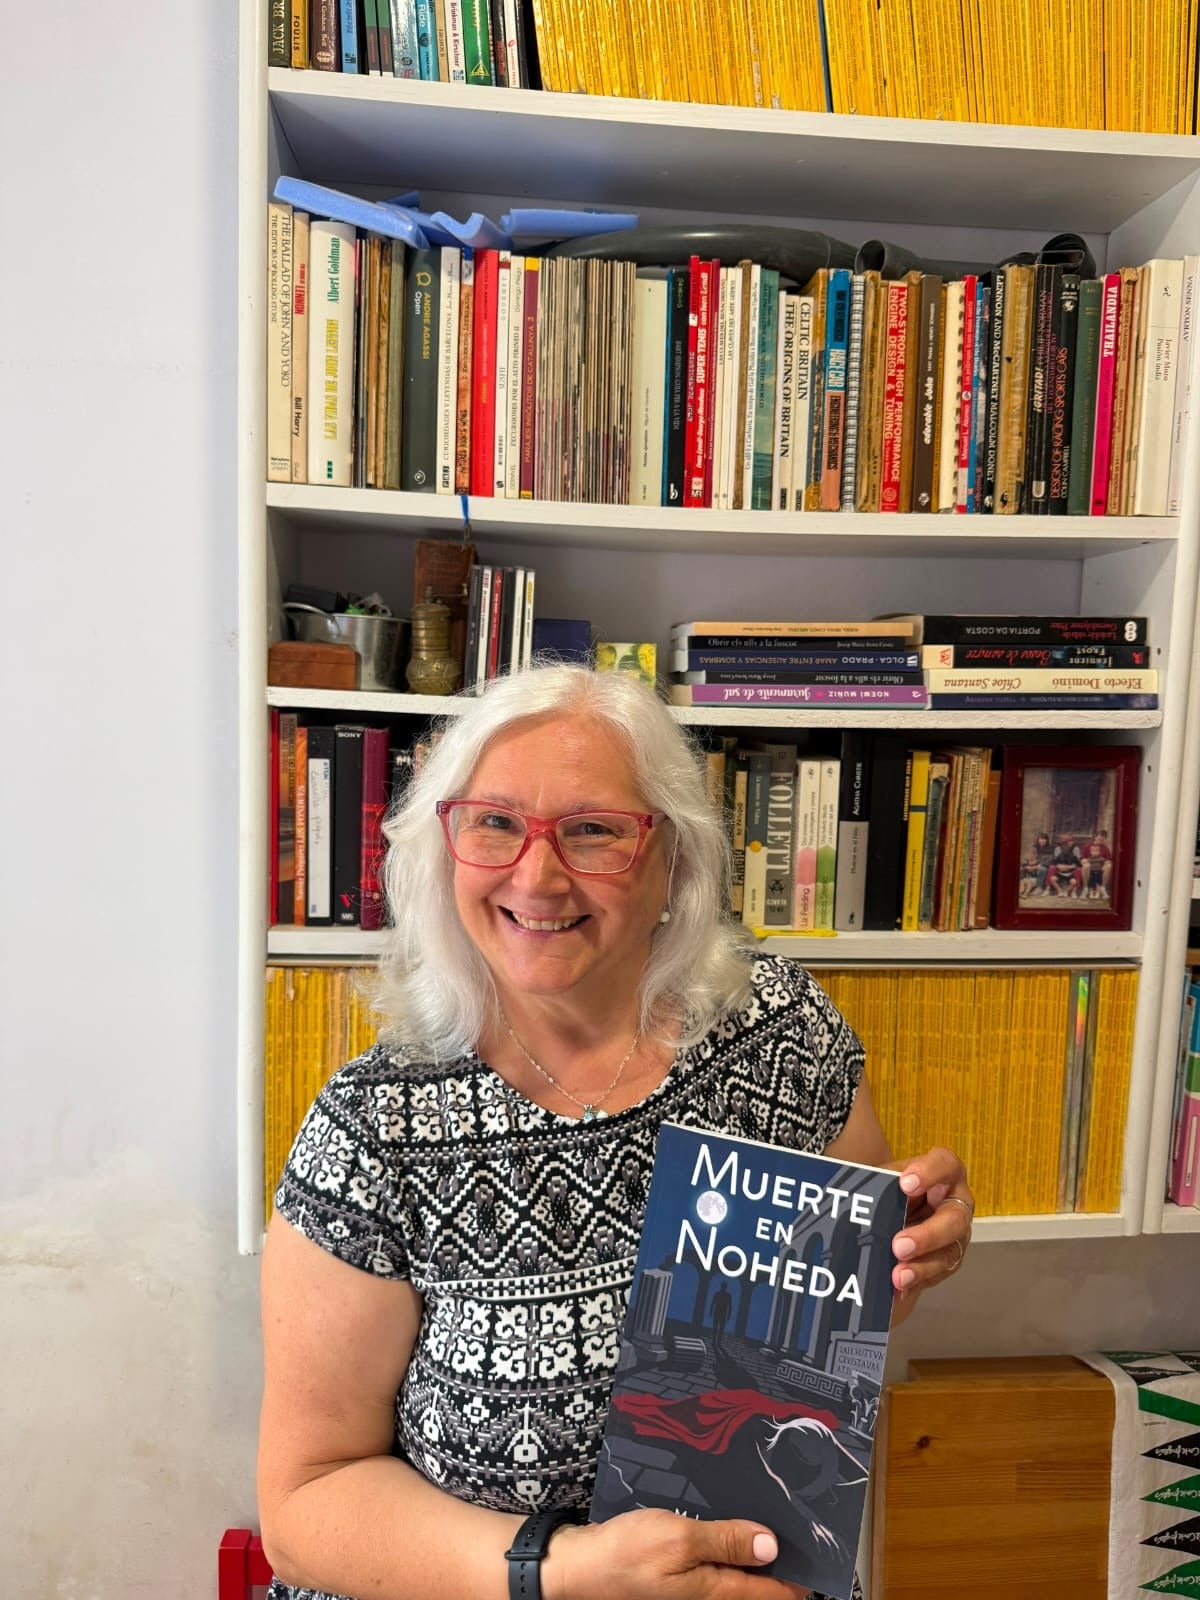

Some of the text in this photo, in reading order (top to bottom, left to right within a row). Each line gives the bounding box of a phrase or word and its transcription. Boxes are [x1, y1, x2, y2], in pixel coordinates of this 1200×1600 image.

[419, 4, 427, 28] Ride
[272, 24, 284, 54] JACK
[270, 270, 278, 300] ROLLING
[327, 237, 340, 304] Albert Goldman
[700, 272, 709, 295] Lendl
[270, 300, 278, 324] STONE
[280, 215, 291, 388] THE BALLAD OF JOHN AND YOKO
[294, 285, 305, 316] LENNON
[414, 291, 423, 315] Open
[514, 286, 522, 312] Domingo
[888, 287, 898, 329] ENGINE
[1181, 276, 1194, 342] AYRTON SENNA
[422, 293, 431, 360] ANDRE AGASSI
[1103, 286, 1118, 357] THAILANDIA
[697, 327, 707, 353] TENIS
[797, 302, 811, 401] CELTIC BRITAIN
[1032, 290, 1047, 413] ¡GRITAD! PHILIP NORMAN
[1163, 338, 1173, 361] Javier
[696, 355, 706, 384] SUPER
[887, 335, 898, 376] DESIGN
[1154, 337, 1164, 381] Pasión india
[780, 301, 795, 458] THE ORIGINS OF BRITAIN
[886, 383, 896, 391] &
[891, 288, 908, 482] TWO-STROKE HIGH PERFORMANCE
[986, 275, 1005, 482] LENNON AND McCARTNEY MALCOLM DONEY
[292, 411, 302, 438] Harry
[885, 397, 895, 439] TUNING
[922, 376, 934, 444] adorable John
[1050, 347, 1068, 498] DESIGN OF RACING SPORTS CARS
[323, 422, 338, 440] LAS
[524, 428, 532, 463] PARAJES
[1060, 446, 1070, 498] COLIN CAMPBELL
[965, 626, 1041, 635] PORTIA DA COSTA
[699, 656, 736, 665] SOMBRAS
[744, 656, 787, 664] AUSENCIAS
[789, 656, 813, 664] ENTRE
[814, 656, 838, 664] AMAR
[841, 656, 905, 664] OLGA PRADO
[1006, 649, 1019, 666] de
[815, 674, 839, 683] foscor
[881, 674, 904, 684] Obrir
[943, 678, 1021, 691] Chloe Santana
[1051, 678, 1143, 690] Efecto Dominó
[722, 686, 812, 702] Juramento de sal
[851, 763, 863, 816] AGATHA CHRISTIE
[766, 771, 794, 875] FOLLETT
[800, 887, 810, 927] Liz Fielding
[691, 1143, 874, 1227] MUERTE
[755, 1217, 793, 1245] EN
[675, 1219, 863, 1307] NOHEDA
